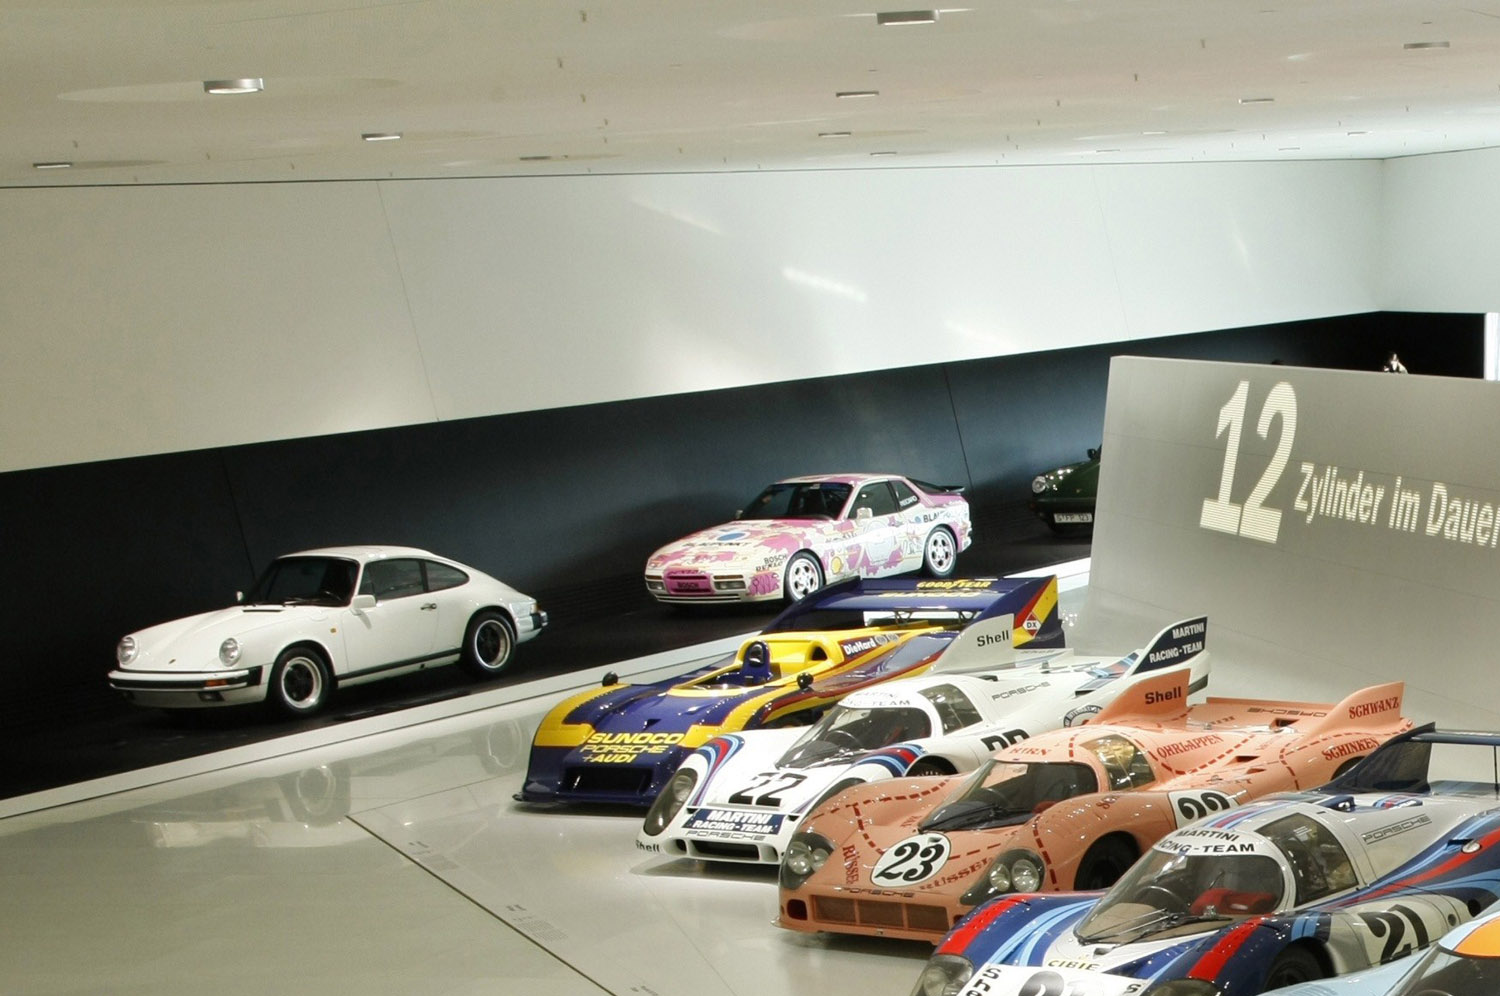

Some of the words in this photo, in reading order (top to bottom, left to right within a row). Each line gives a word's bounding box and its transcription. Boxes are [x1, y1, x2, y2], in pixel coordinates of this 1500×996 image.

[1199, 380, 1298, 544] 12
[1294, 462, 1385, 525] Zylinder
[1026, 621, 1037, 629] DX
[1172, 622, 1205, 640] MARTINI
[843, 638, 877, 655] DieHard
[976, 630, 1009, 647] Shell
[1149, 641, 1203, 664] RACING-TEAM
[1144, 686, 1182, 705] Shell
[1348, 696, 1400, 720] SCHWANZ
[586, 732, 686, 745] SUNOCO
[580, 744, 670, 754] PORSCHE
[1321, 737, 1380, 761] SCHINKEN
[728, 772, 808, 806] 22
[706, 810, 772, 825] MARTINI
[685, 830, 766, 841] PORSCHE
[1175, 829, 1240, 842] MARTINI
[1363, 816, 1433, 843] PORSCHE
[635, 840, 660, 853] Shell
[874, 842, 945, 882] 23
[1357, 904, 1430, 965] 21
